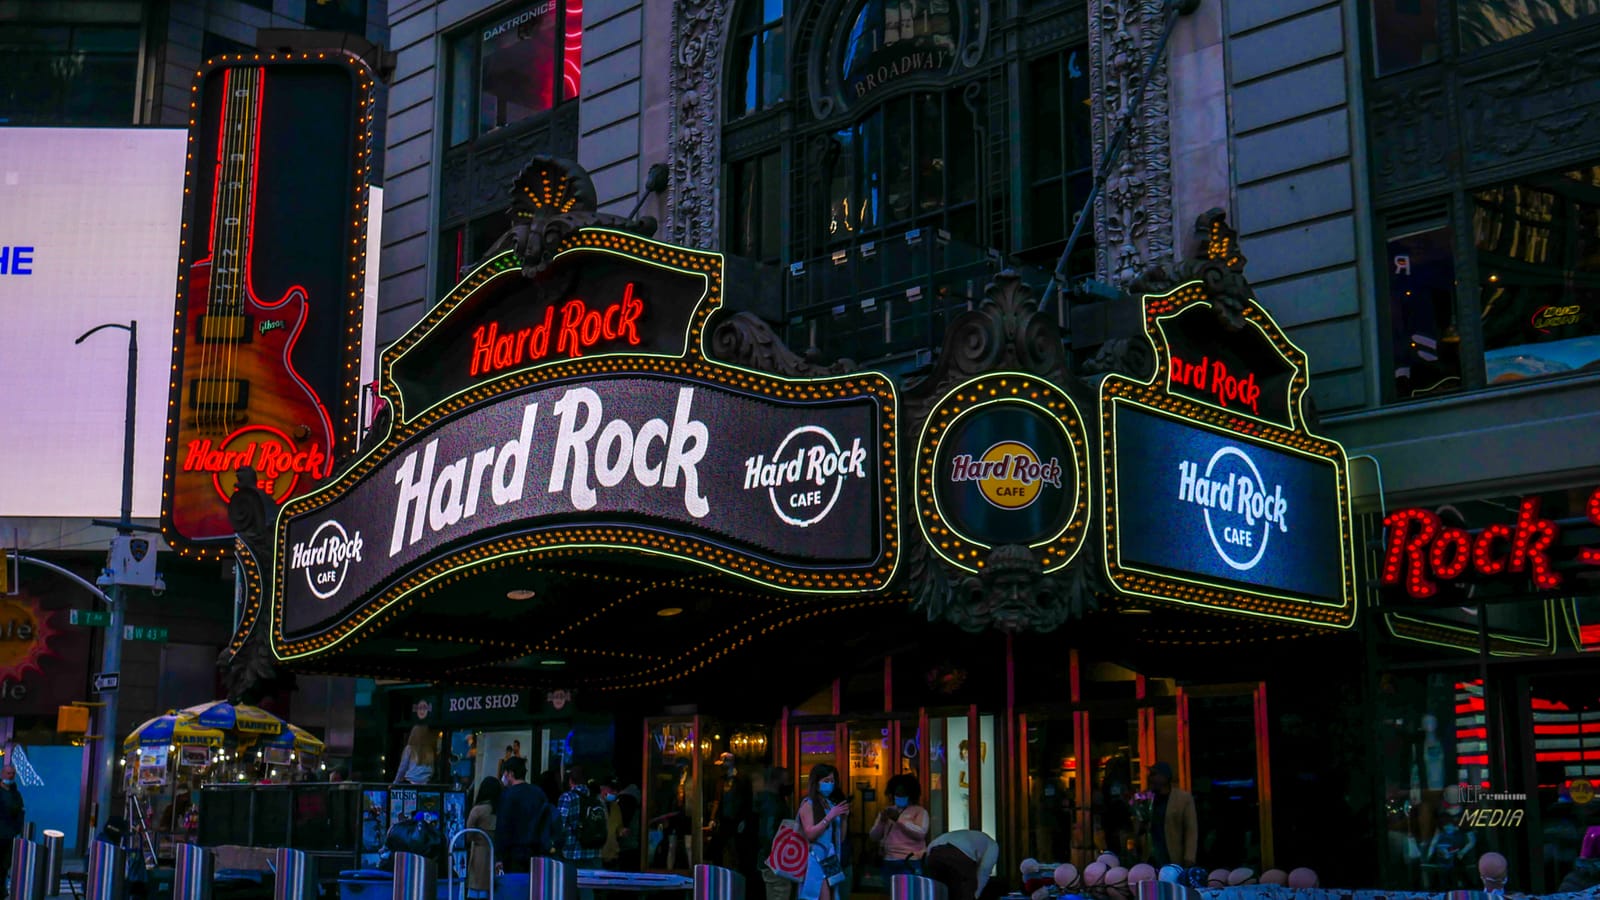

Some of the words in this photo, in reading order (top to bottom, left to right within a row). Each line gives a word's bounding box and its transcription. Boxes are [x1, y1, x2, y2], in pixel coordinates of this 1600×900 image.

[483, 0, 556, 41] DAKTRONICS
[855, 50, 947, 97] BROADWAY
[470, 305, 554, 376] Hard
[557, 283, 643, 358] Rock
[1170, 356, 1209, 390] ard
[1212, 361, 1261, 415] Rock
[183, 439, 257, 471] Hard
[256, 440, 325, 479] Rock
[389, 402, 538, 558] Hard
[548, 387, 710, 518] Rock
[744, 448, 805, 490] Hard
[806, 438, 867, 485] Rock
[952, 454, 1012, 481] Hard
[1012, 454, 1062, 488] Rock
[790, 491, 821, 507] CAFE
[996, 487, 1025, 497] CAFE
[1179, 460, 1235, 512] Hard
[1238, 475, 1287, 533] Rock
[291, 538, 328, 569] Hard
[328, 530, 363, 568] Rock
[1224, 527, 1252, 547] CAFE
[1381, 496, 1563, 599] Rock
[317, 571, 336, 584] CAFE
[135, 626, 143, 638] W
[146, 629, 156, 640] 43
[449, 696, 483, 712] ROCK
[485, 693, 519, 710] SHOP
[391, 791, 417, 800] MUSIC
